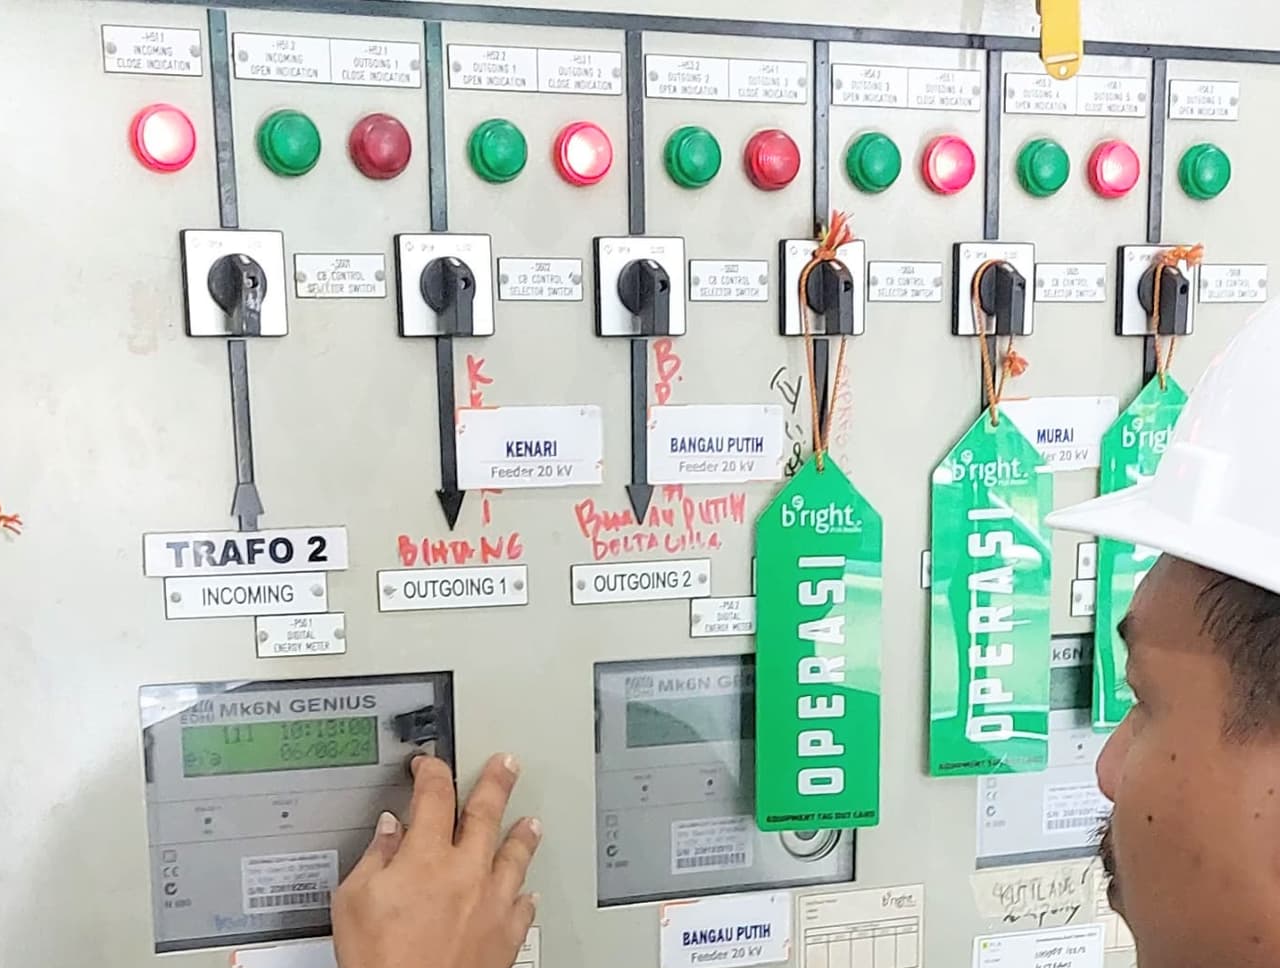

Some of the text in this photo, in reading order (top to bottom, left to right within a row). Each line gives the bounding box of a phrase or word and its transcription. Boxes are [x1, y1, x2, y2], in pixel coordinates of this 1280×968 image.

[134, 45, 172, 56] INCOMING
[265, 53, 303, 64] INCOMING
[116, 58, 191, 71] CLOSE INDICATION
[250, 64, 318, 78] OPEN INDICATION
[353, 57, 391, 69] OUTGOING
[472, 62, 509, 74] OUTGOING
[341, 69, 411, 82] CLOSE INDICATION
[462, 75, 526, 87] OPEN INDICATION
[1036, 428, 1075, 444] MURAI
[505, 440, 558, 458] KENARI
[670, 437, 764, 453] BANGAU PUTIH
[1059, 449, 1089, 461] 20 kV
[491, 465, 573, 478] Feeder 20 kV
[679, 461, 754, 473] Feeder 20 kV
[165, 535, 328, 569] TRAFO 2
[403, 577, 507, 599] OUTGOING 1
[593, 570, 693, 593] OUTGOING 2
[201, 585, 294, 607] INCOMING
[967, 507, 1015, 742] OPERASI
[1052, 647, 1084, 662] k6N
[796, 554, 847, 797] OPERASI
[657, 677, 711, 693] Mk6N
[220, 694, 377, 718] Mk6N GENIUS
[682, 923, 771, 946] BANGAU PUTIH
[690, 946, 762, 964] Feeder 20 kV
